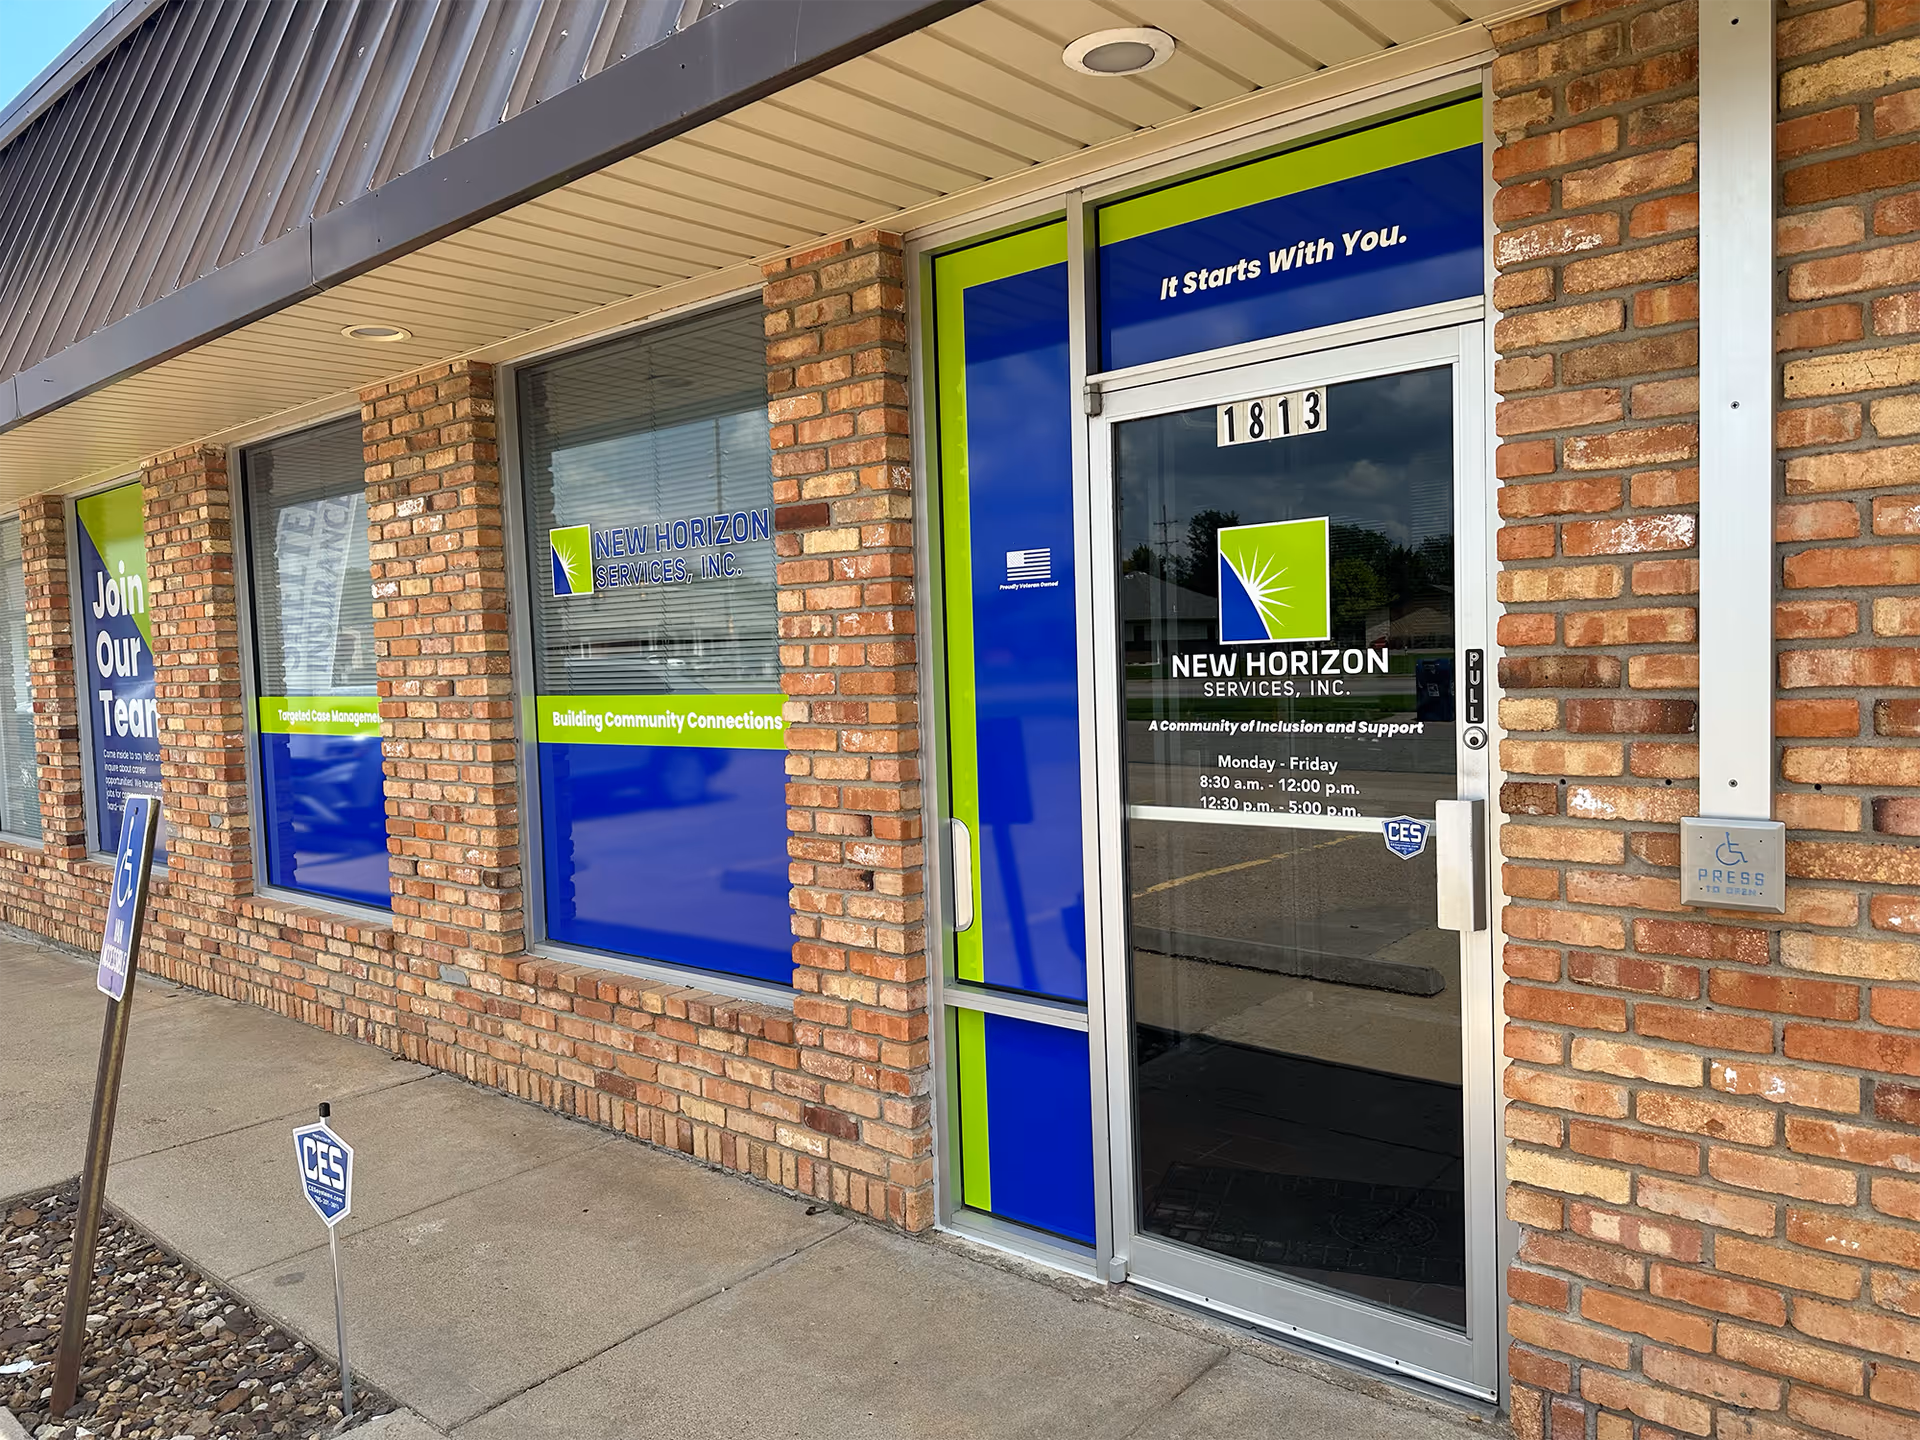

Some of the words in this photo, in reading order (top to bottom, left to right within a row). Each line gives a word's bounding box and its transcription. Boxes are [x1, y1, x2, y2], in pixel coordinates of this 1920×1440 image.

[1160, 276, 1178, 300] It
[1182, 259, 1261, 294] Starts
[1268, 239, 1334, 273] With
[1342, 225, 1407, 256] You.
[1224, 391, 1320, 442] 1813
[595, 525, 648, 559] NEW
[654, 508, 770, 553] HORIZON
[596, 558, 693, 589] SERVICES,
[701, 552, 743, 579] INC.
[93, 560, 144, 619] Join
[96, 630, 141, 678] Our
[1172, 653, 1237, 678] NEW
[1246, 648, 1390, 677] HORIZON
[1203, 681, 1300, 698] SERVICES,
[1310, 680, 1351, 696] INC.
[1469, 651, 1480, 721] PULL
[278, 709, 310, 725] Targeted
[311, 709, 330, 722] Case
[553, 710, 603, 732] Building
[604, 711, 684, 733] Community
[687, 711, 783, 730] Connections
[1149, 720, 1158, 732] A
[1160, 719, 1239, 736] Community
[1240, 719, 1256, 733] of
[1256, 719, 1322, 733] Inclusion
[1325, 721, 1356, 734] and
[1358, 721, 1424, 737] Support
[104, 749, 116, 759] Come
[116, 749, 129, 760] inside
[129, 751, 135, 760] to
[135, 753, 143, 763] say
[143, 752, 153, 762] hello
[1217, 754, 1276, 773] Monday
[1289, 756, 1338, 775] Friday
[104, 762, 119, 774] inquire
[119, 763, 132, 773] about
[132, 765, 147, 774] career
[106, 788, 115, 800] jobs
[134, 779, 142, 787] We
[142, 779, 153, 789] have
[1200, 775, 1230, 789] 8:30
[1234, 779, 1264, 791] a.m.
[1278, 778, 1320, 793] 12:00
[1325, 782, 1360, 797] p.m.
[1200, 796, 1238, 810] 12:30
[1243, 801, 1275, 814] p.m.
[1288, 800, 1322, 815] 5:00
[1326, 805, 1362, 818] p.m.
[1388, 822, 1422, 843] CES
[1698, 868, 1765, 886] PRESS
[1706, 885, 1720, 893] TO
[1726, 887, 1757, 896] OPEN
[303, 1136, 345, 1191] CES
